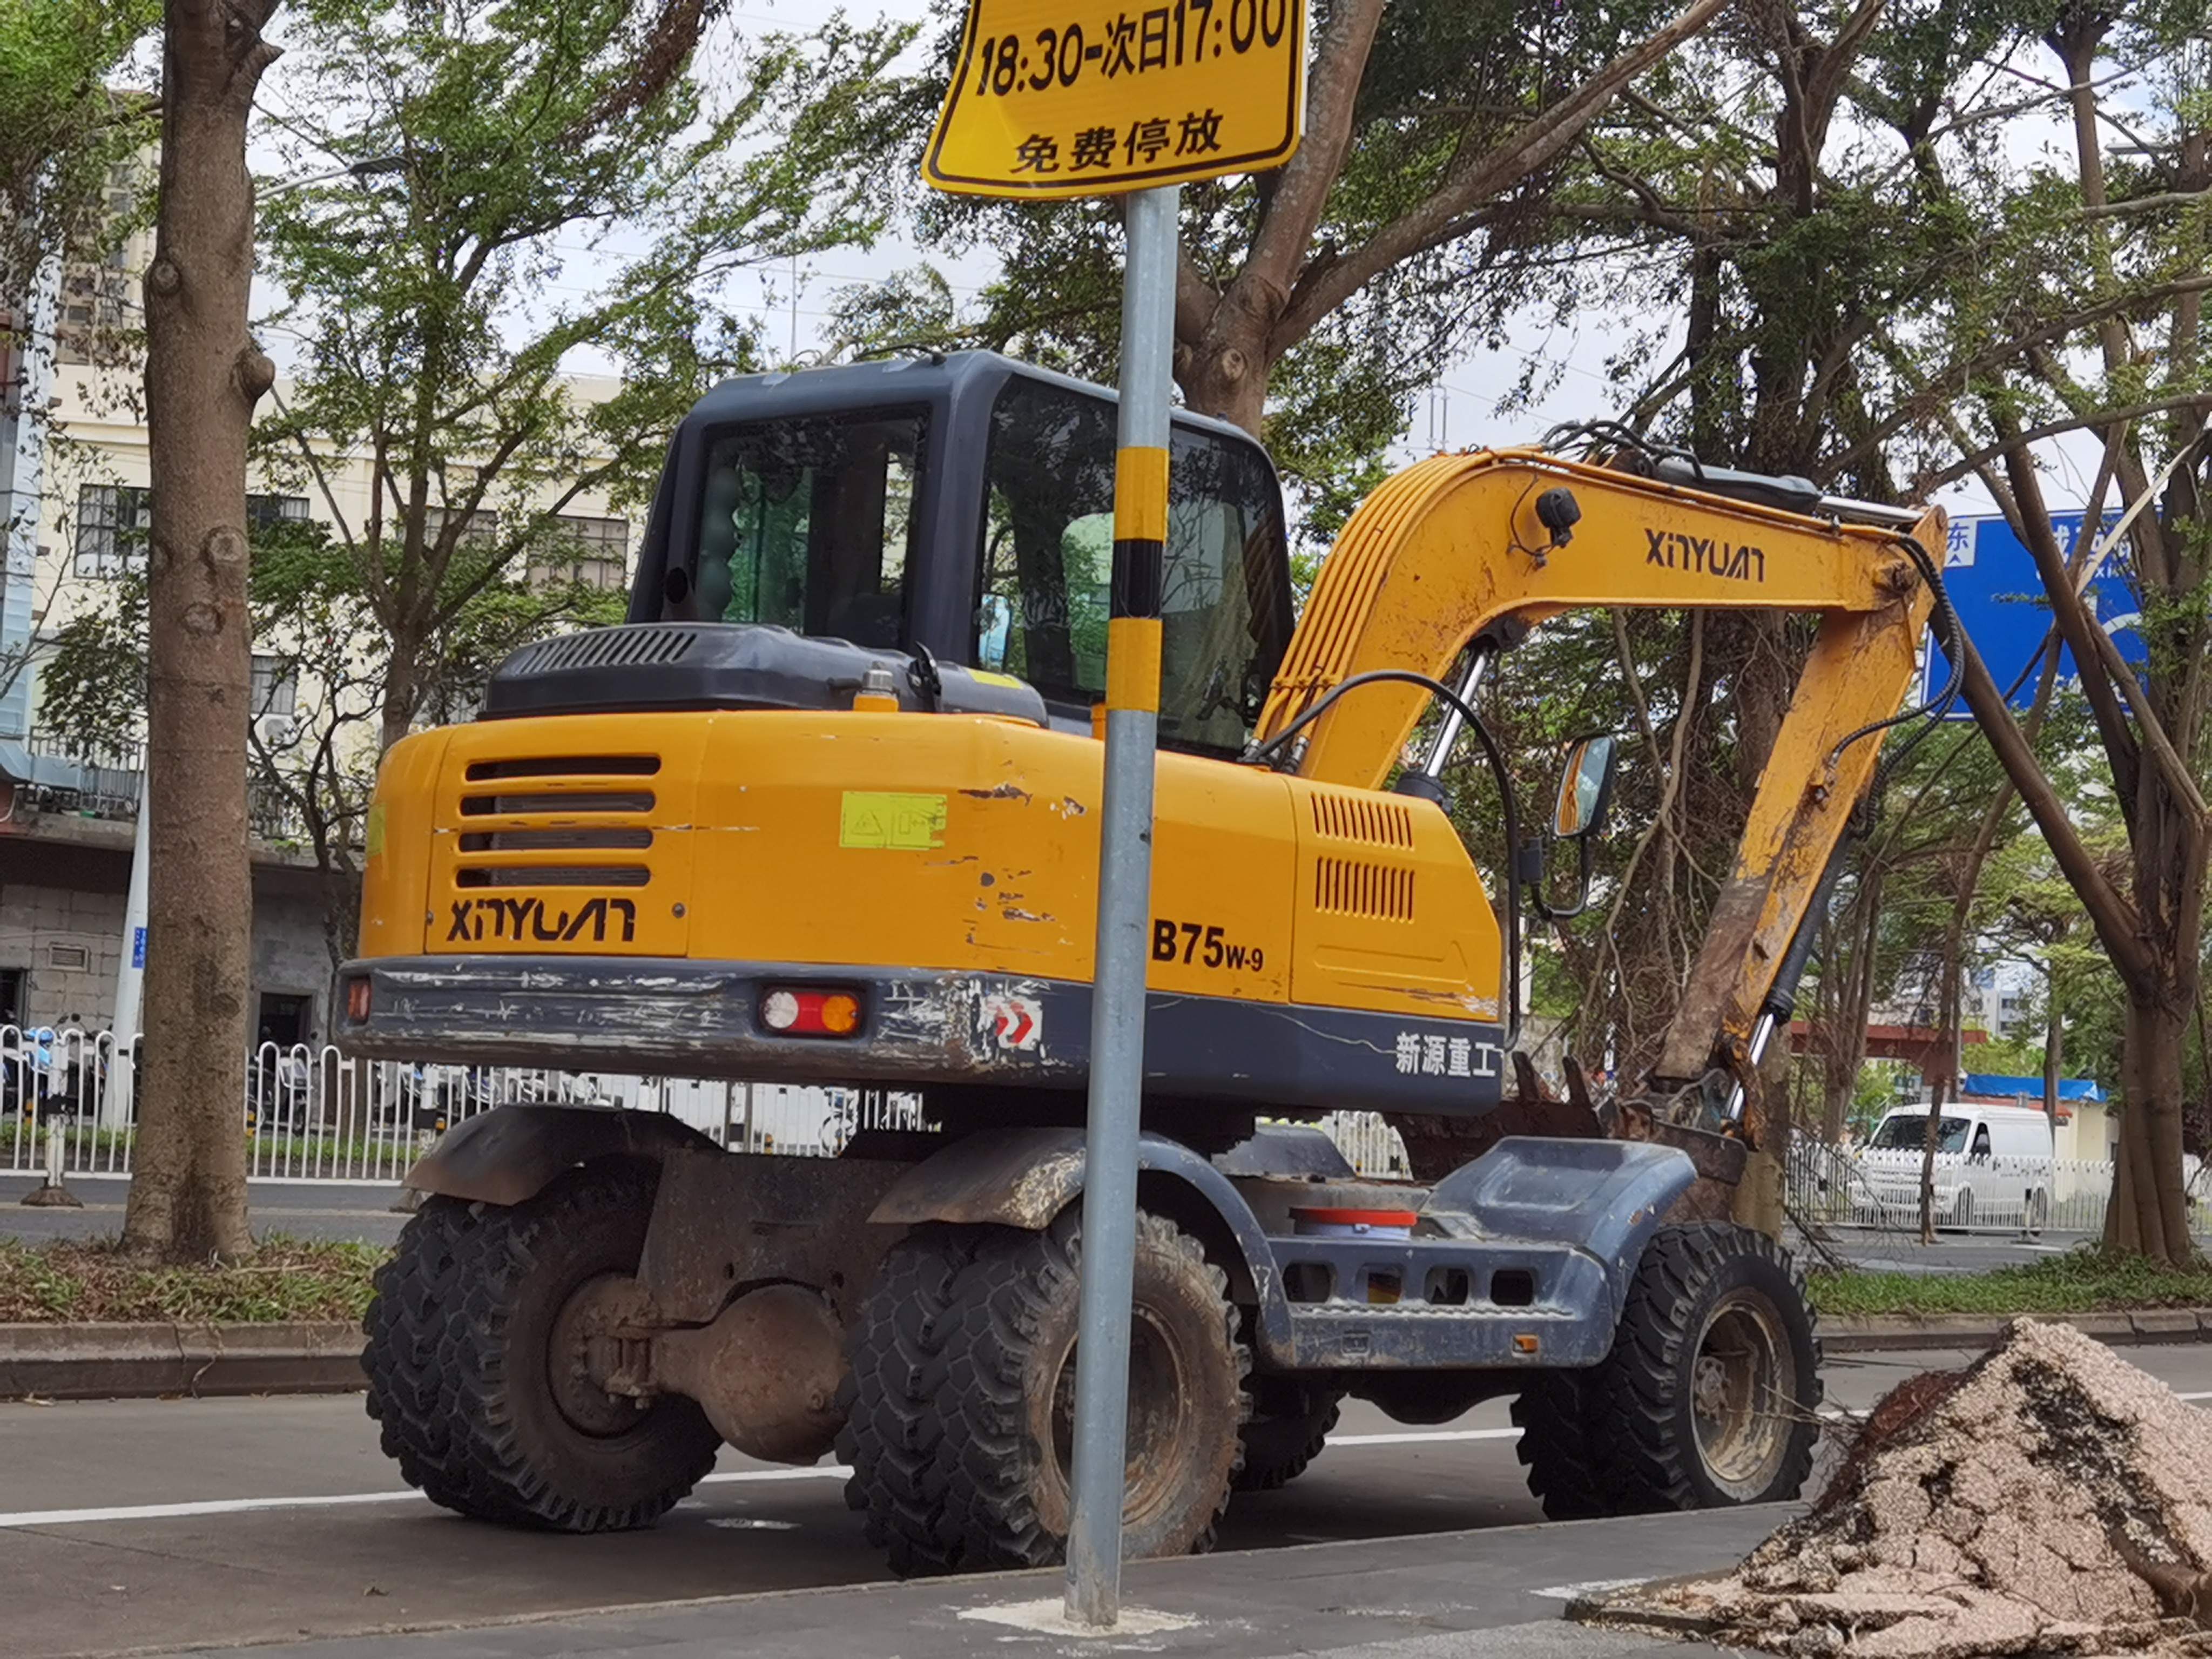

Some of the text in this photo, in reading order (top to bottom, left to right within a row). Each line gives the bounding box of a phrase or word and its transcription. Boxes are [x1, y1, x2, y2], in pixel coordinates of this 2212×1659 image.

[1009, 108, 1224, 174] 免费停放
[1946, 522, 1970, 551] 东
[1395, 1030, 1496, 1077] 新源重工
